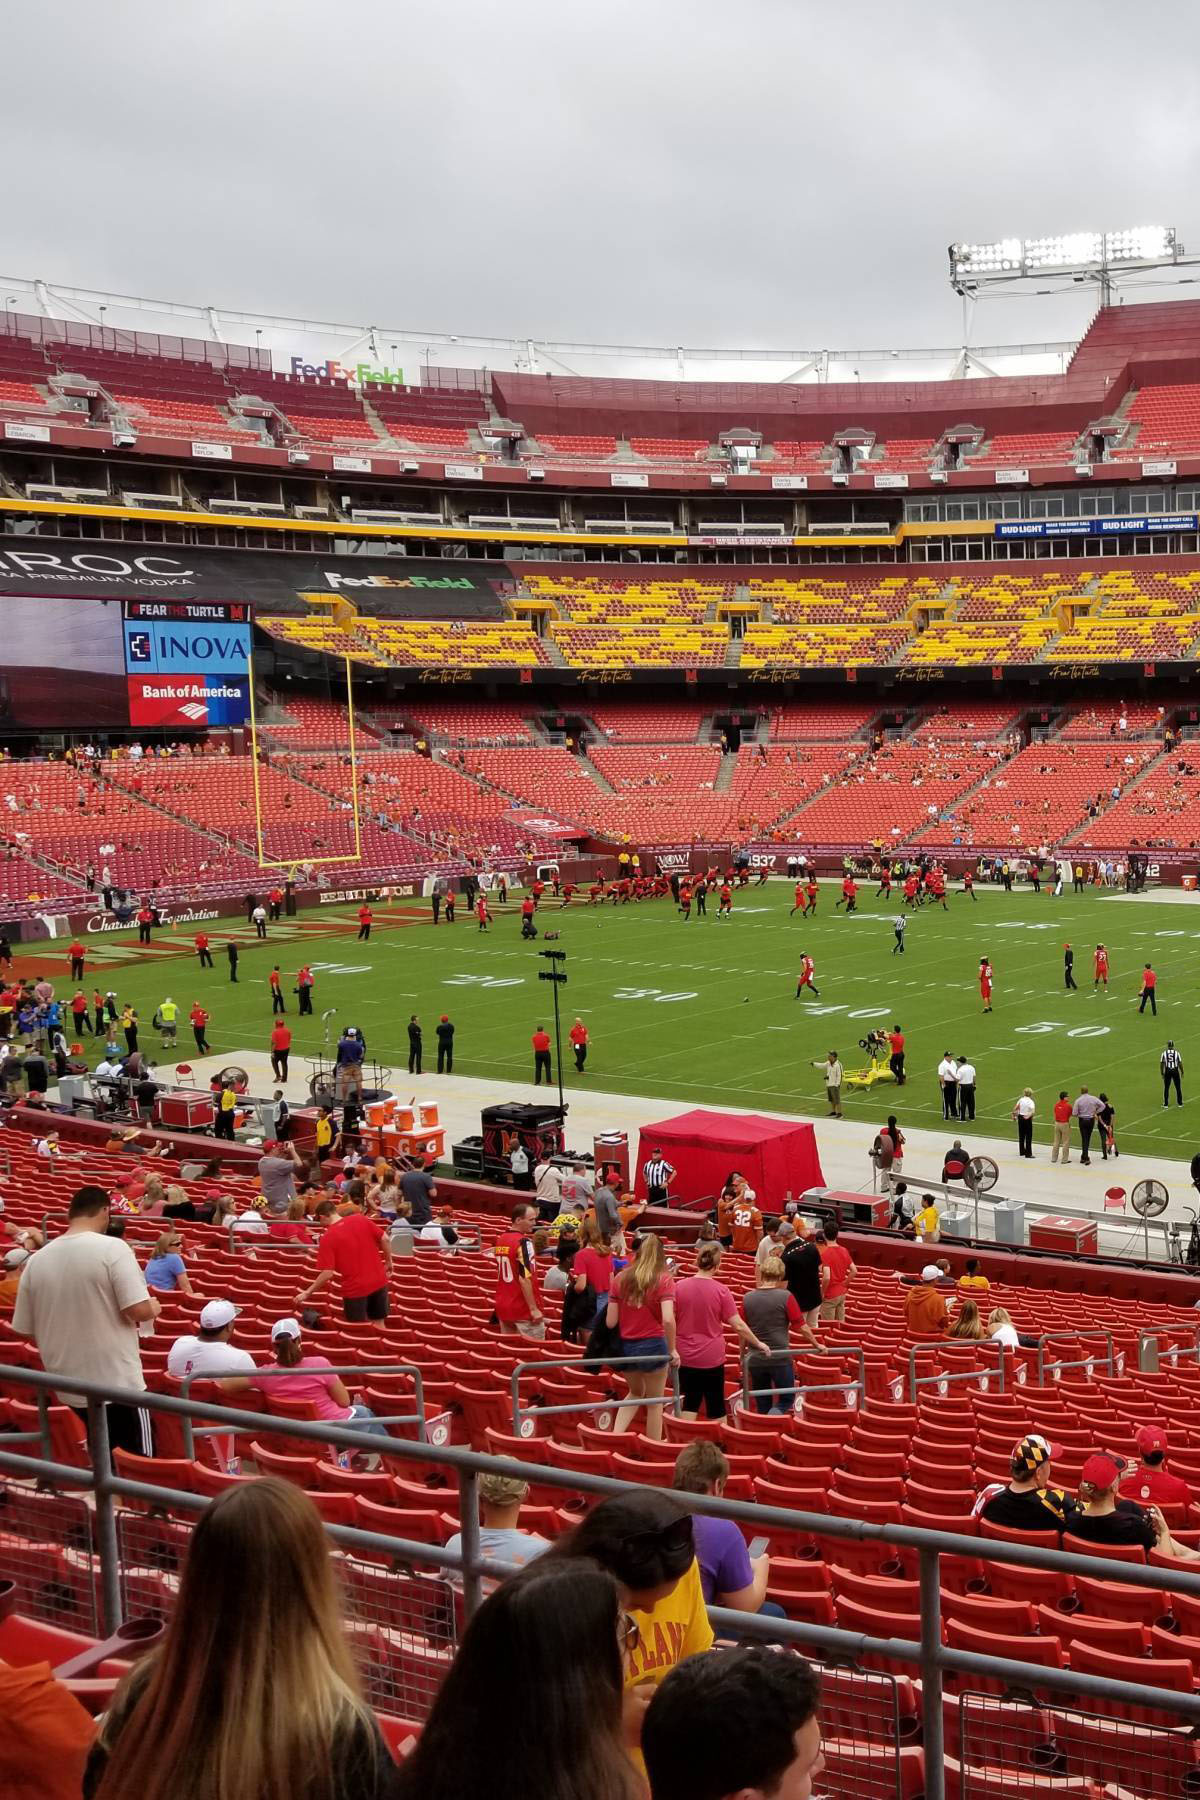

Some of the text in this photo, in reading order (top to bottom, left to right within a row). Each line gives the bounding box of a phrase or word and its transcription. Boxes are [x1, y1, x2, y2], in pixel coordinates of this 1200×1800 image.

[291, 357, 403, 385] FedExField
[1002, 525, 1043, 534] BUD LIGHT
[1102, 520, 1144, 530] BUD LIGHT
[28, 573, 196, 586] PREMIUM VODKA
[324, 572, 476, 589] FedExField
[160, 636, 248, 659] INOVA
[142, 685, 241, 698] Bank of America
[748, 855, 777, 867] 1937
[1014, 1021, 1111, 1038] 50
[426, 1140, 437, 1153] G
[734, 1209, 752, 1227] 32
